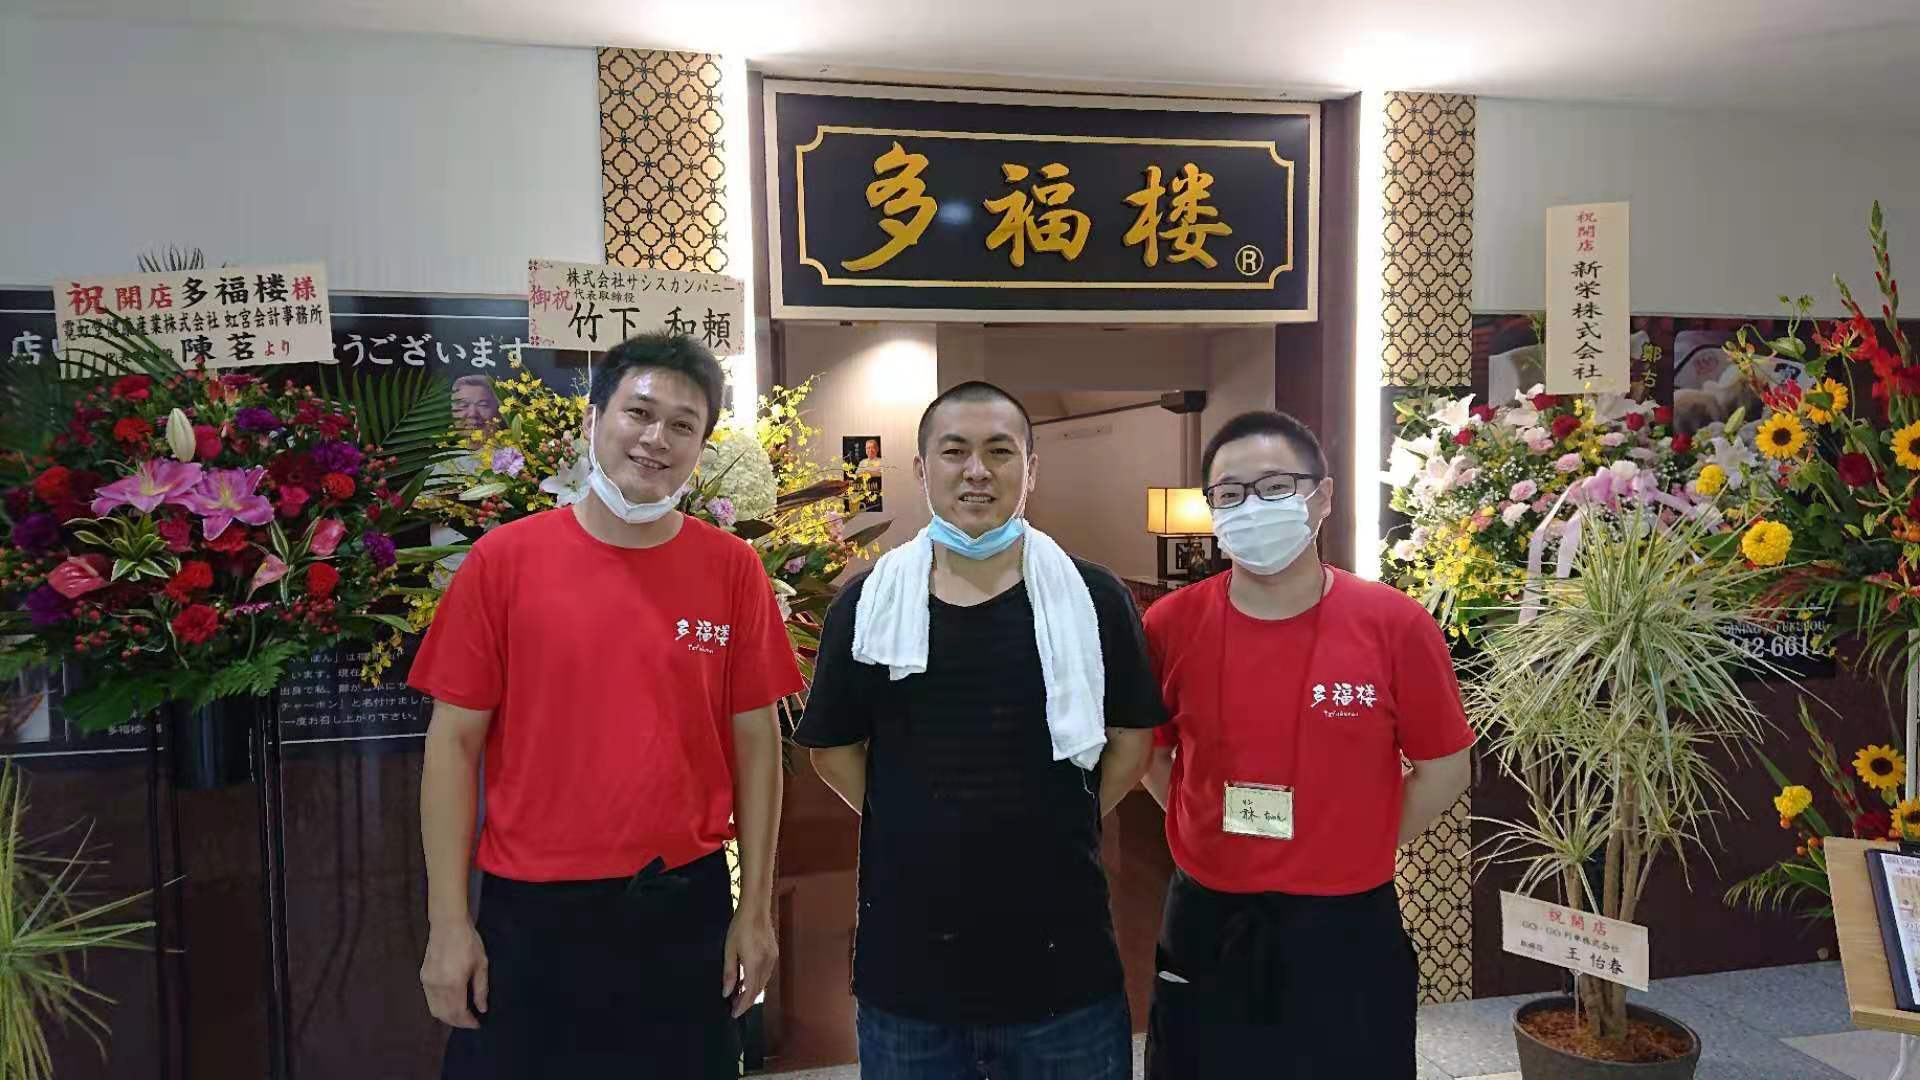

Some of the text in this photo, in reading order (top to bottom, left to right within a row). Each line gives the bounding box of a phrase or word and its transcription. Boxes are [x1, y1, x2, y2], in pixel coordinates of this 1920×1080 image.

[841, 141, 1233, 272] 多福楼
[1576, 211, 1597, 252] 祝開店
[530, 285, 573, 313] 御祝
[574, 289, 636, 304] 代表取締役
[1571, 260, 1604, 381] 新栄株式会社
[330, 333, 530, 367] うございます
[675, 618, 730, 646] 多福楼
[1311, 682, 1377, 708] 多福楼
